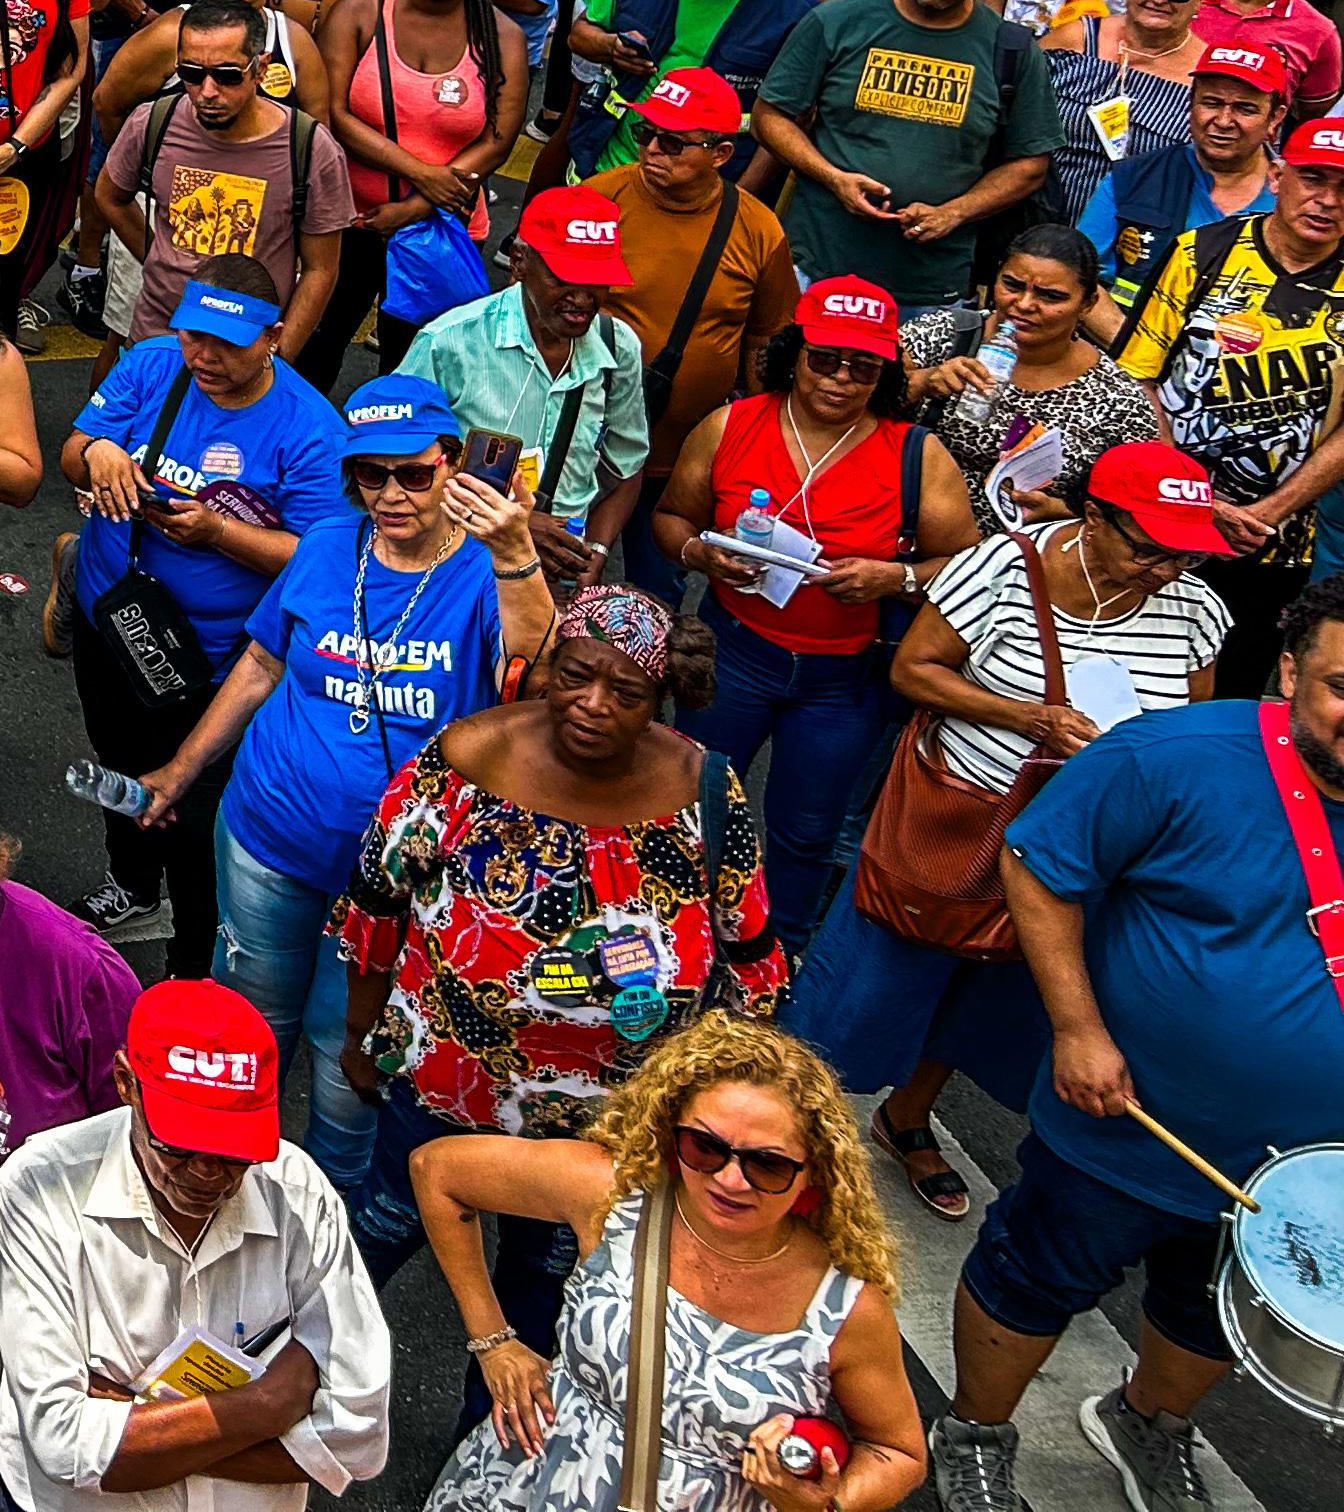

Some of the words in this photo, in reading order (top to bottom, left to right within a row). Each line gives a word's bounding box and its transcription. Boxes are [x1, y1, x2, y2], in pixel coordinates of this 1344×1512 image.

[871, 54, 968, 80] PARENTAL
[863, 67, 968, 105] ADVISORY
[860, 89, 906, 109] EXPLICIT
[909, 98, 962, 118] CONTENT
[566, 219, 617, 241] CUT
[200, 295, 244, 313] APROFEM
[823, 294, 879, 318] CUT
[348, 404, 413, 424] APROFEM
[325, 674, 359, 707] na
[167, 1045, 253, 1083] CUT
